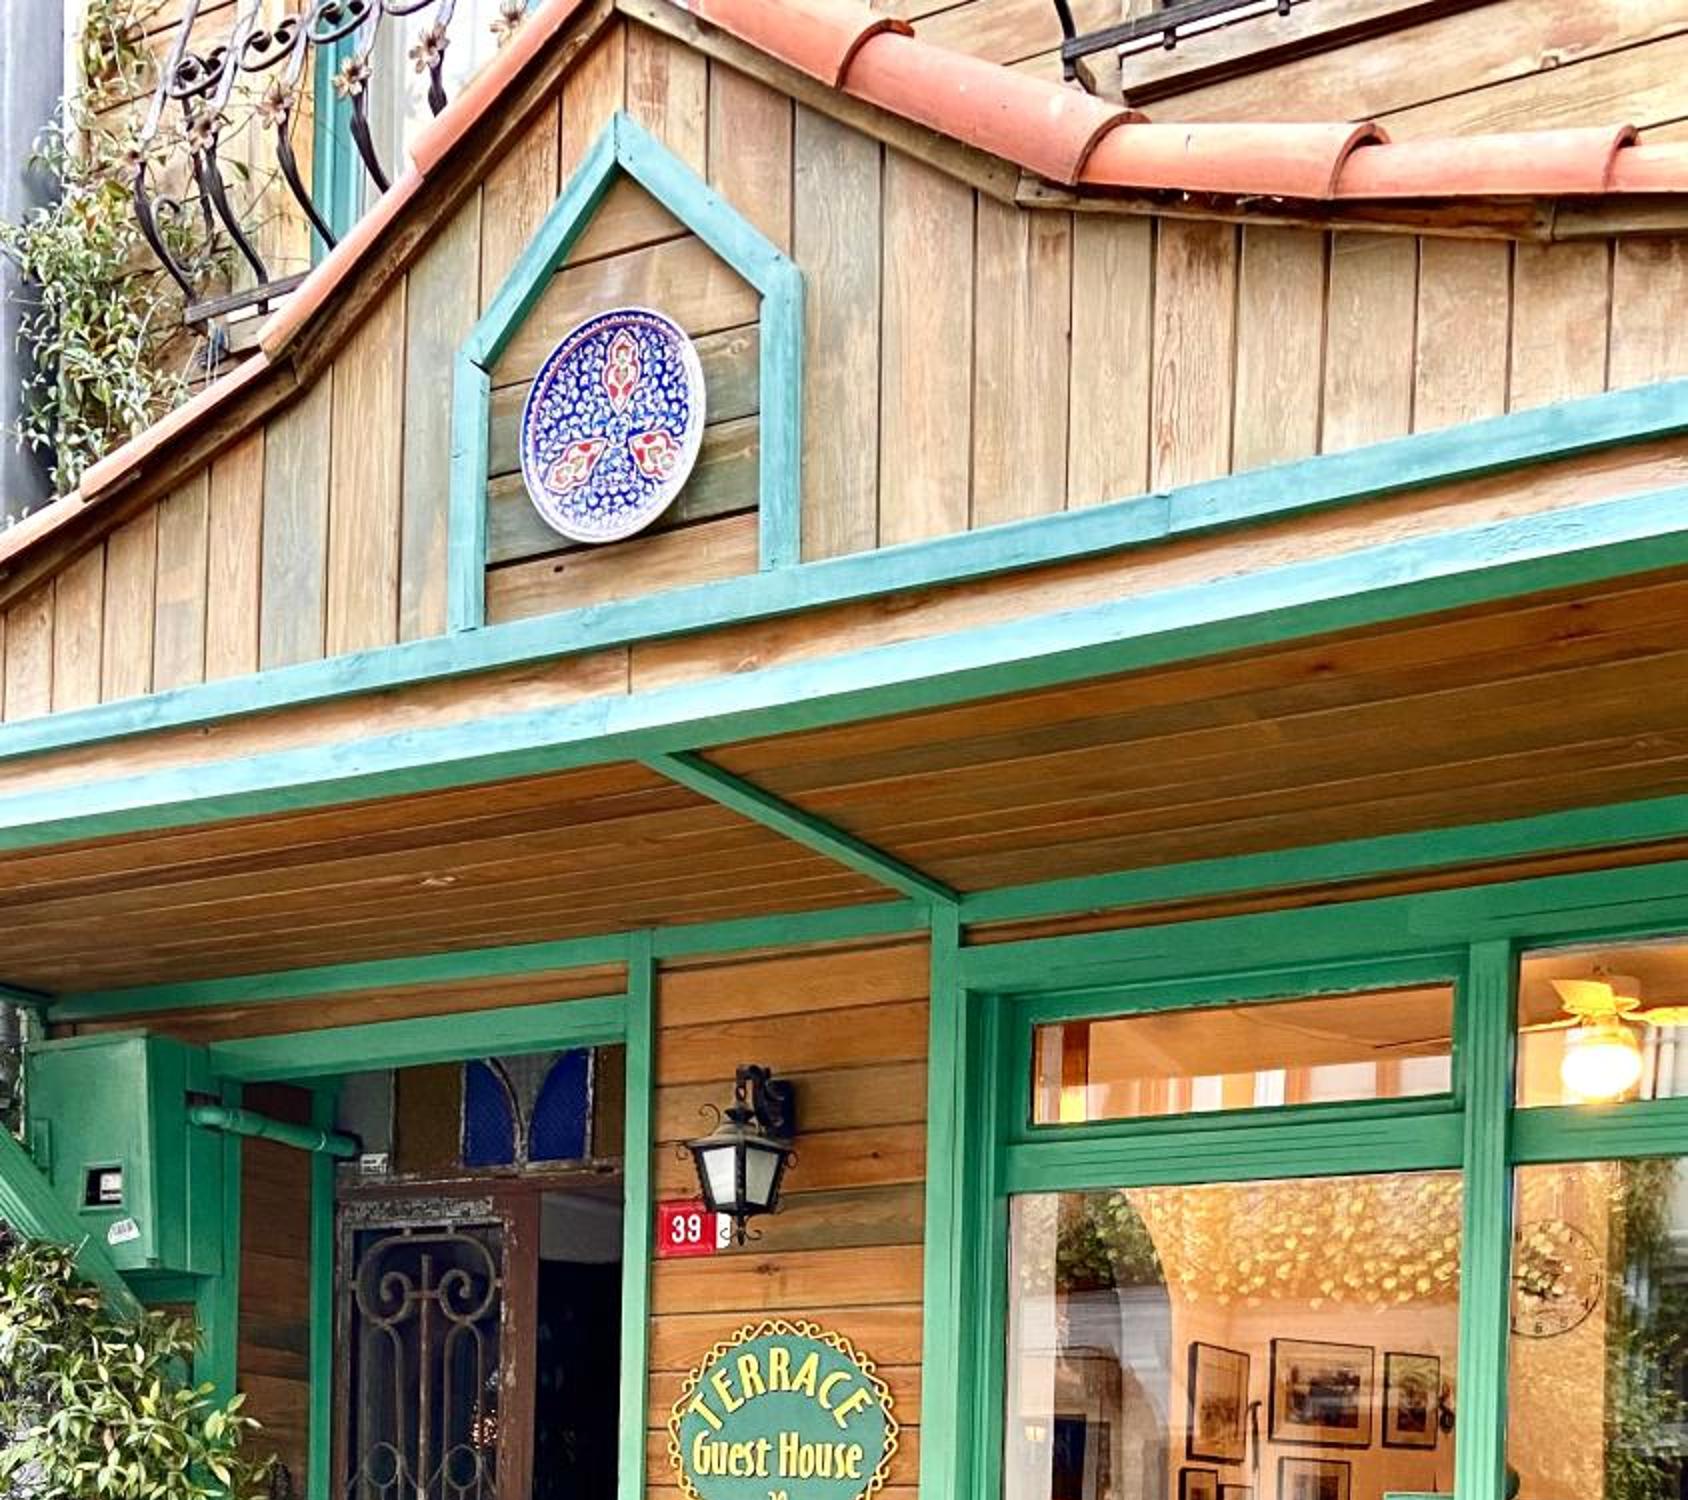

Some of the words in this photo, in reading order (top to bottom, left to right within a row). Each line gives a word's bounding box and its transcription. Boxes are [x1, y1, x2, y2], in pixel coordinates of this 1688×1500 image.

[671, 1215, 701, 1243] 39
[688, 1347, 874, 1431] TERRACE
[692, 1430, 772, 1478] Guest
[778, 1431, 864, 1480] House
